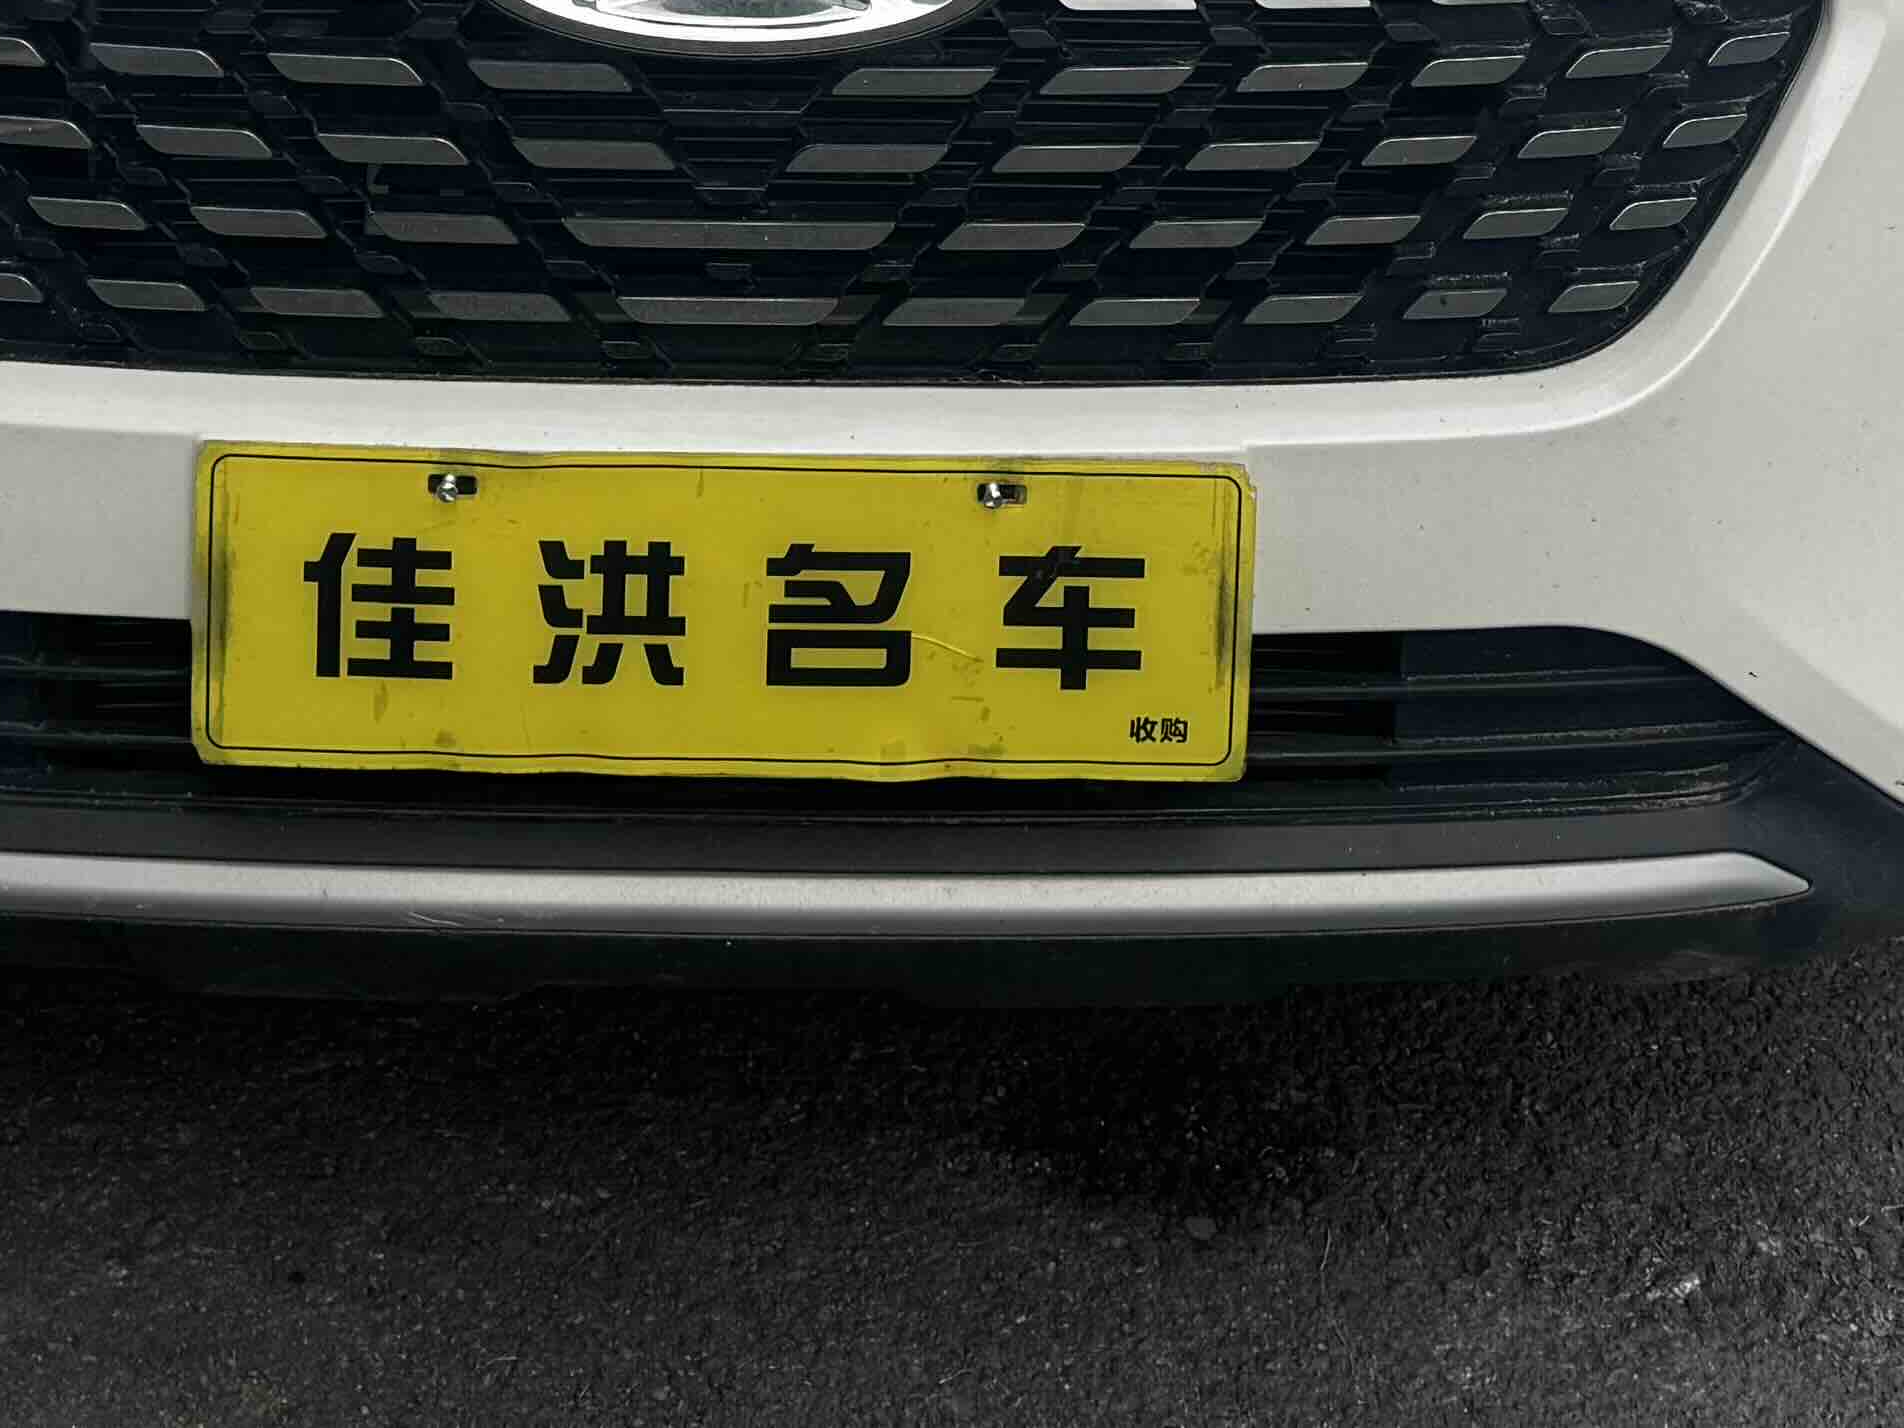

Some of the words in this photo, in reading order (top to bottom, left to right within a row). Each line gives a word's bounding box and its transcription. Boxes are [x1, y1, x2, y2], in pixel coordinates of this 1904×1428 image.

[302, 532, 1148, 691] 佳洪名车
[1129, 716, 1189, 744] 收购
